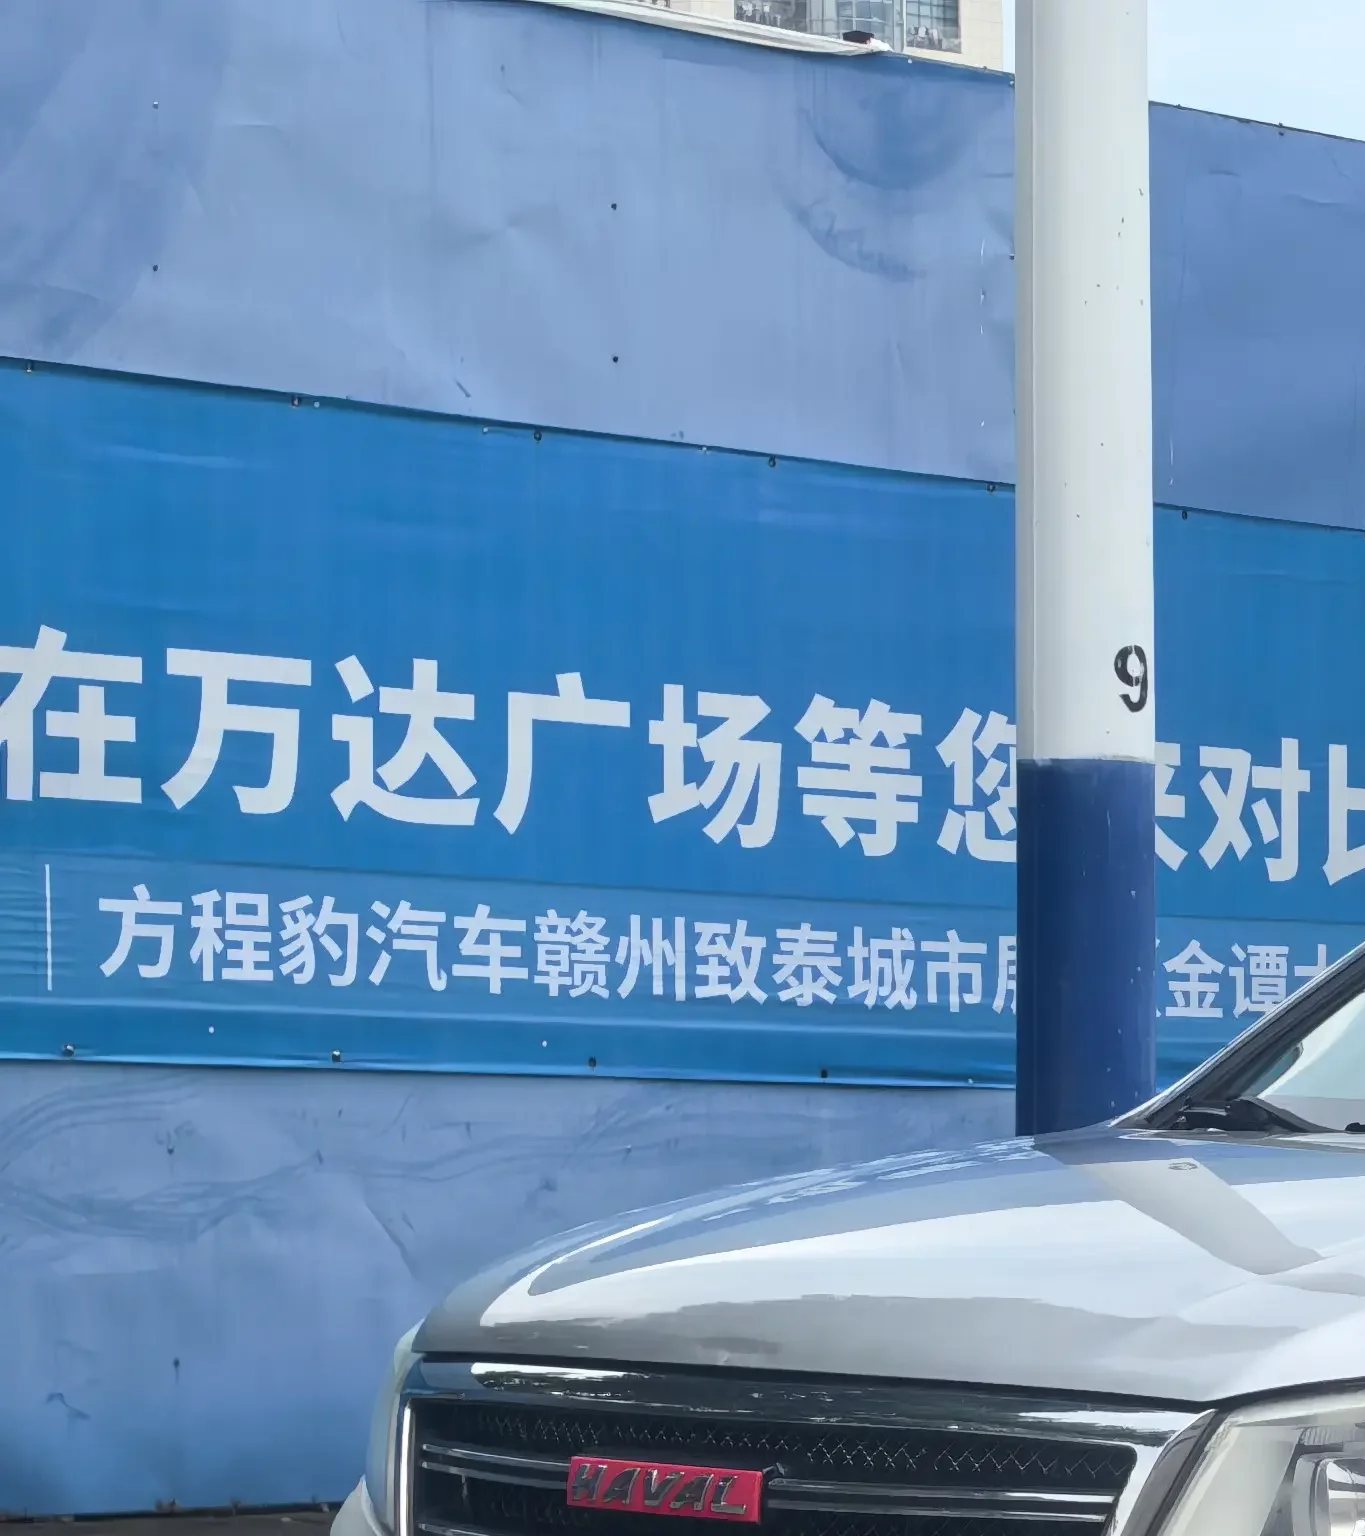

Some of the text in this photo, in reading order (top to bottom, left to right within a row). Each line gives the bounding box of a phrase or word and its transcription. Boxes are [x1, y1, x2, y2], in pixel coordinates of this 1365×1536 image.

[1113, 644, 1149, 712] 9
[97, 883, 1328, 1020] 方程豹汽车赣州致泰城市金谭
[571, 1463, 747, 1515] HAVAL
